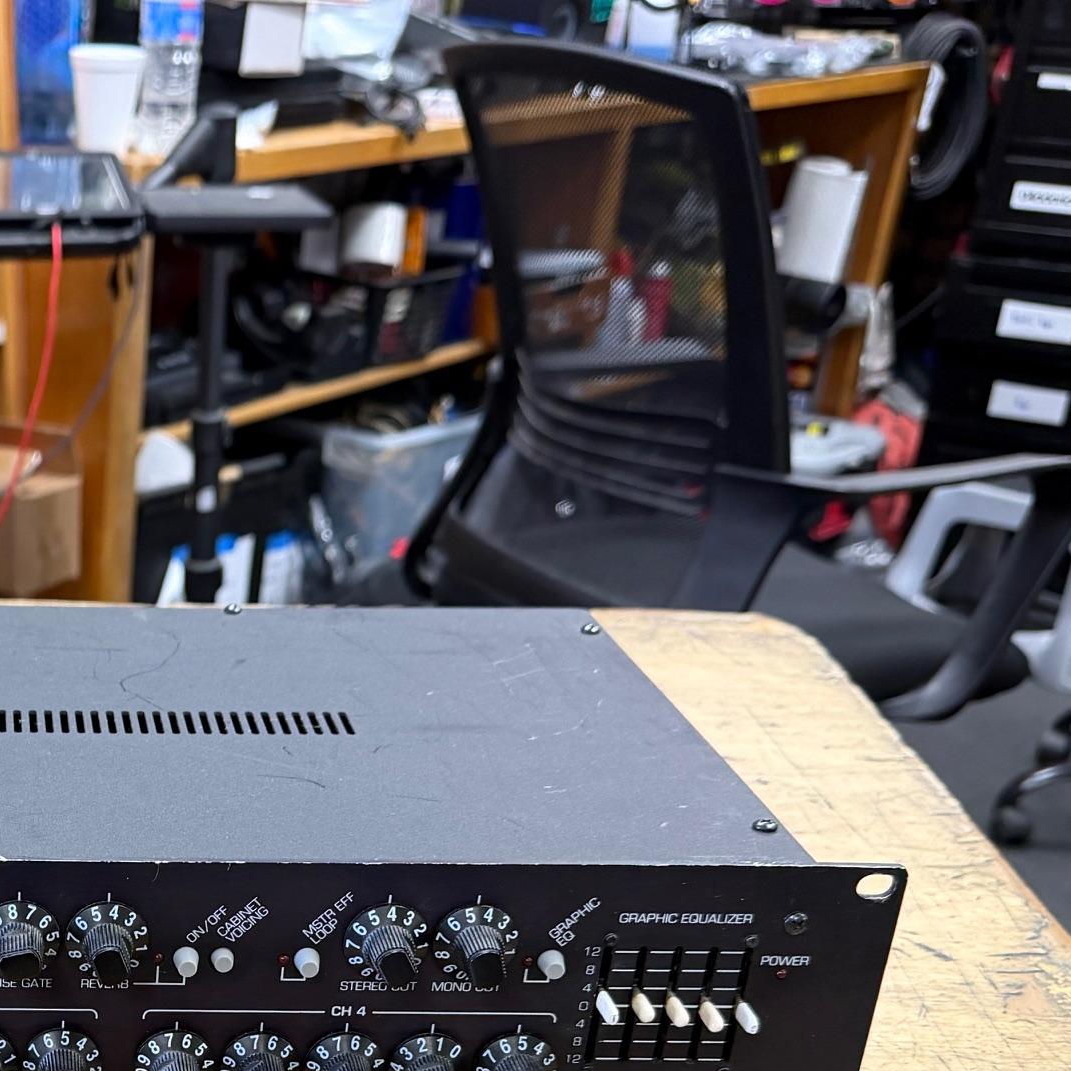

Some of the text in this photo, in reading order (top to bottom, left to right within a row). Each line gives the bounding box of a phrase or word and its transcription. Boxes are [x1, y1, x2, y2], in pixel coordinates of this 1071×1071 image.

[7, 904, 18, 919] 8
[26, 905, 37, 919] 7
[39, 914, 52, 929] 6
[75, 905, 137, 930] 6 5 4 3
[186, 905, 228, 943] ON/OFF
[217, 897, 262, 938] CABINET
[225, 906, 269, 943] VOICING
[302, 891, 354, 938] MSTR EFF
[352, 906, 415, 936] 6 5 4 3
[447, 907, 511, 931] 6 5 4 3
[548, 897, 601, 940] GRAPHIC
[618, 913, 753, 924] GRAPHIC EQUALIZER
[309, 919, 338, 944] LOOP
[556, 931, 576, 947] EQ
[584, 947, 600, 956] 12
[760, 956, 810, 966] POWER
[585, 965, 595, 975] 8
[21, 978, 53, 988] GATE
[81, 979, 128, 988] REVB
[340, 981, 387, 991] STEREO
[431, 982, 471, 992] MONO
[582, 984, 592, 992] 4
[331, 1006, 367, 1016] CH 4
[578, 1002, 588, 1010] 0
[576, 1019, 585, 1028] 4
[28, 1031, 88, 1058] 7 6 5 4
[148, 1033, 208, 1056] 8 7 6 5
[234, 1035, 294, 1058] 8 7 6 5
[316, 1036, 377, 1060] 8 7 6 5
[400, 1037, 461, 1060] 3 2 1 0
[483, 1036, 545, 1063] 7 6 5 4
[573, 1037, 582, 1046] 8
[566, 1054, 581, 1063] 12
